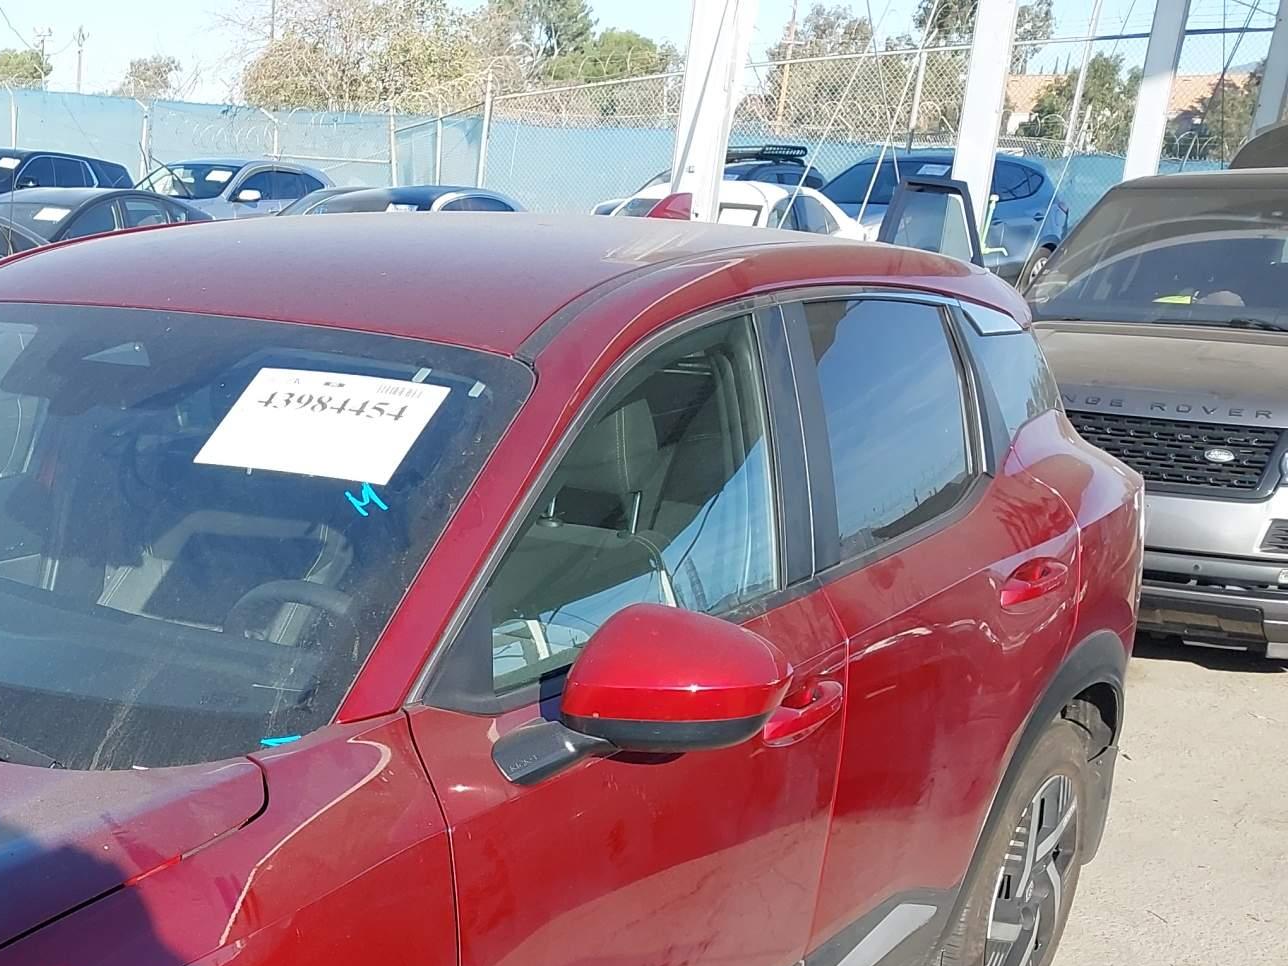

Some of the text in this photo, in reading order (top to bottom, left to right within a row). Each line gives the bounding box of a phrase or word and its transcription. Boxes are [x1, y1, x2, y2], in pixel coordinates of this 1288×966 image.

[258, 391, 409, 421] 43984454
[1064, 394, 1272, 419] NGE ROVER
